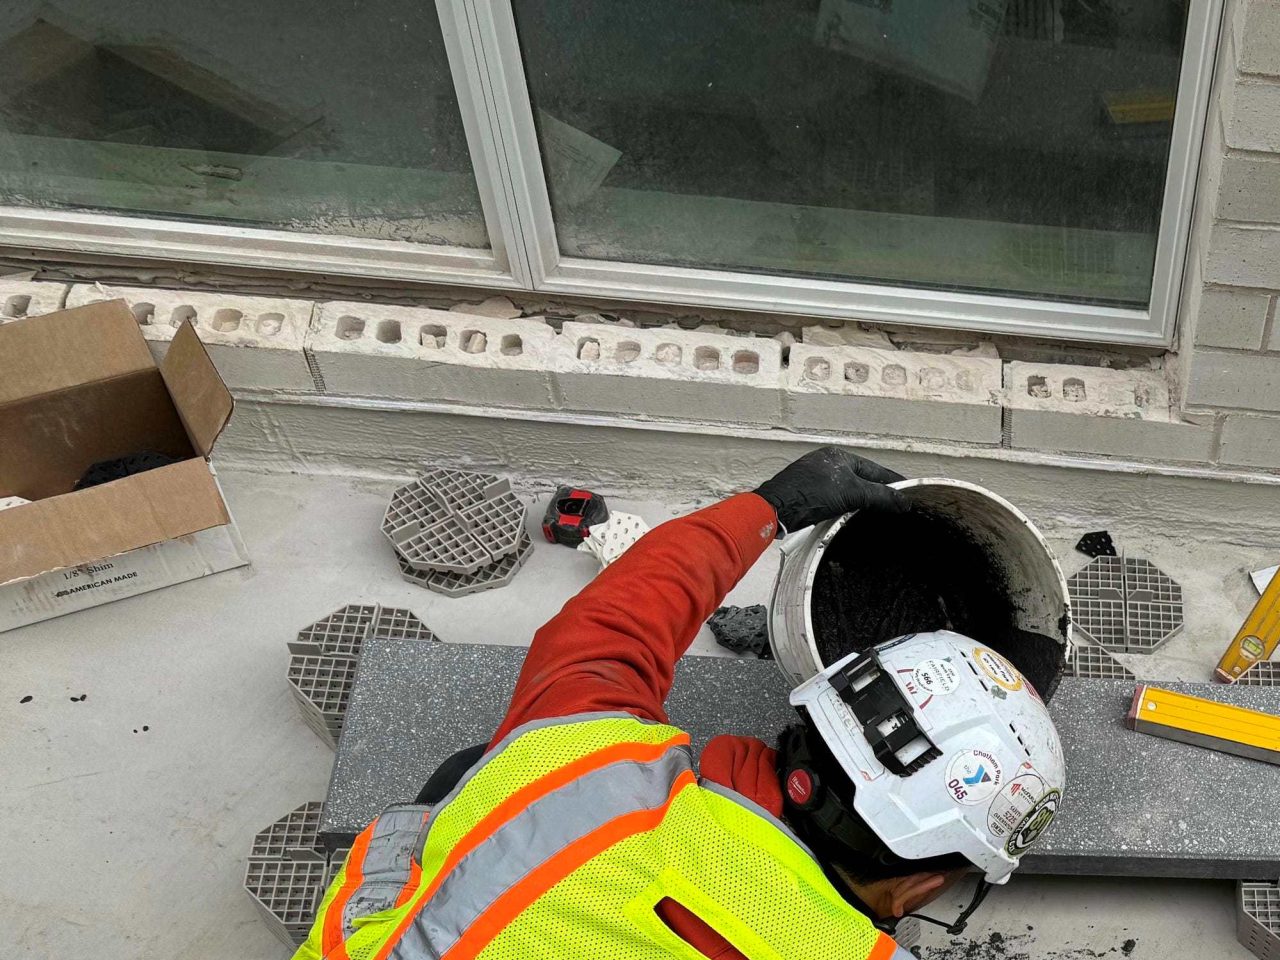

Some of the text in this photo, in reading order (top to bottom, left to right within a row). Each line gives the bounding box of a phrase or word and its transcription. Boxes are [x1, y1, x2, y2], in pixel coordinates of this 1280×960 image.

[87, 562, 114, 575] Shim
[69, 571, 138, 594] AMERICAN MADE
[921, 672, 932, 685] 566
[928, 660, 950, 692] FAIRFIELD
[973, 749, 1001, 786] Chatham Park
[948, 778, 968, 800] 045
